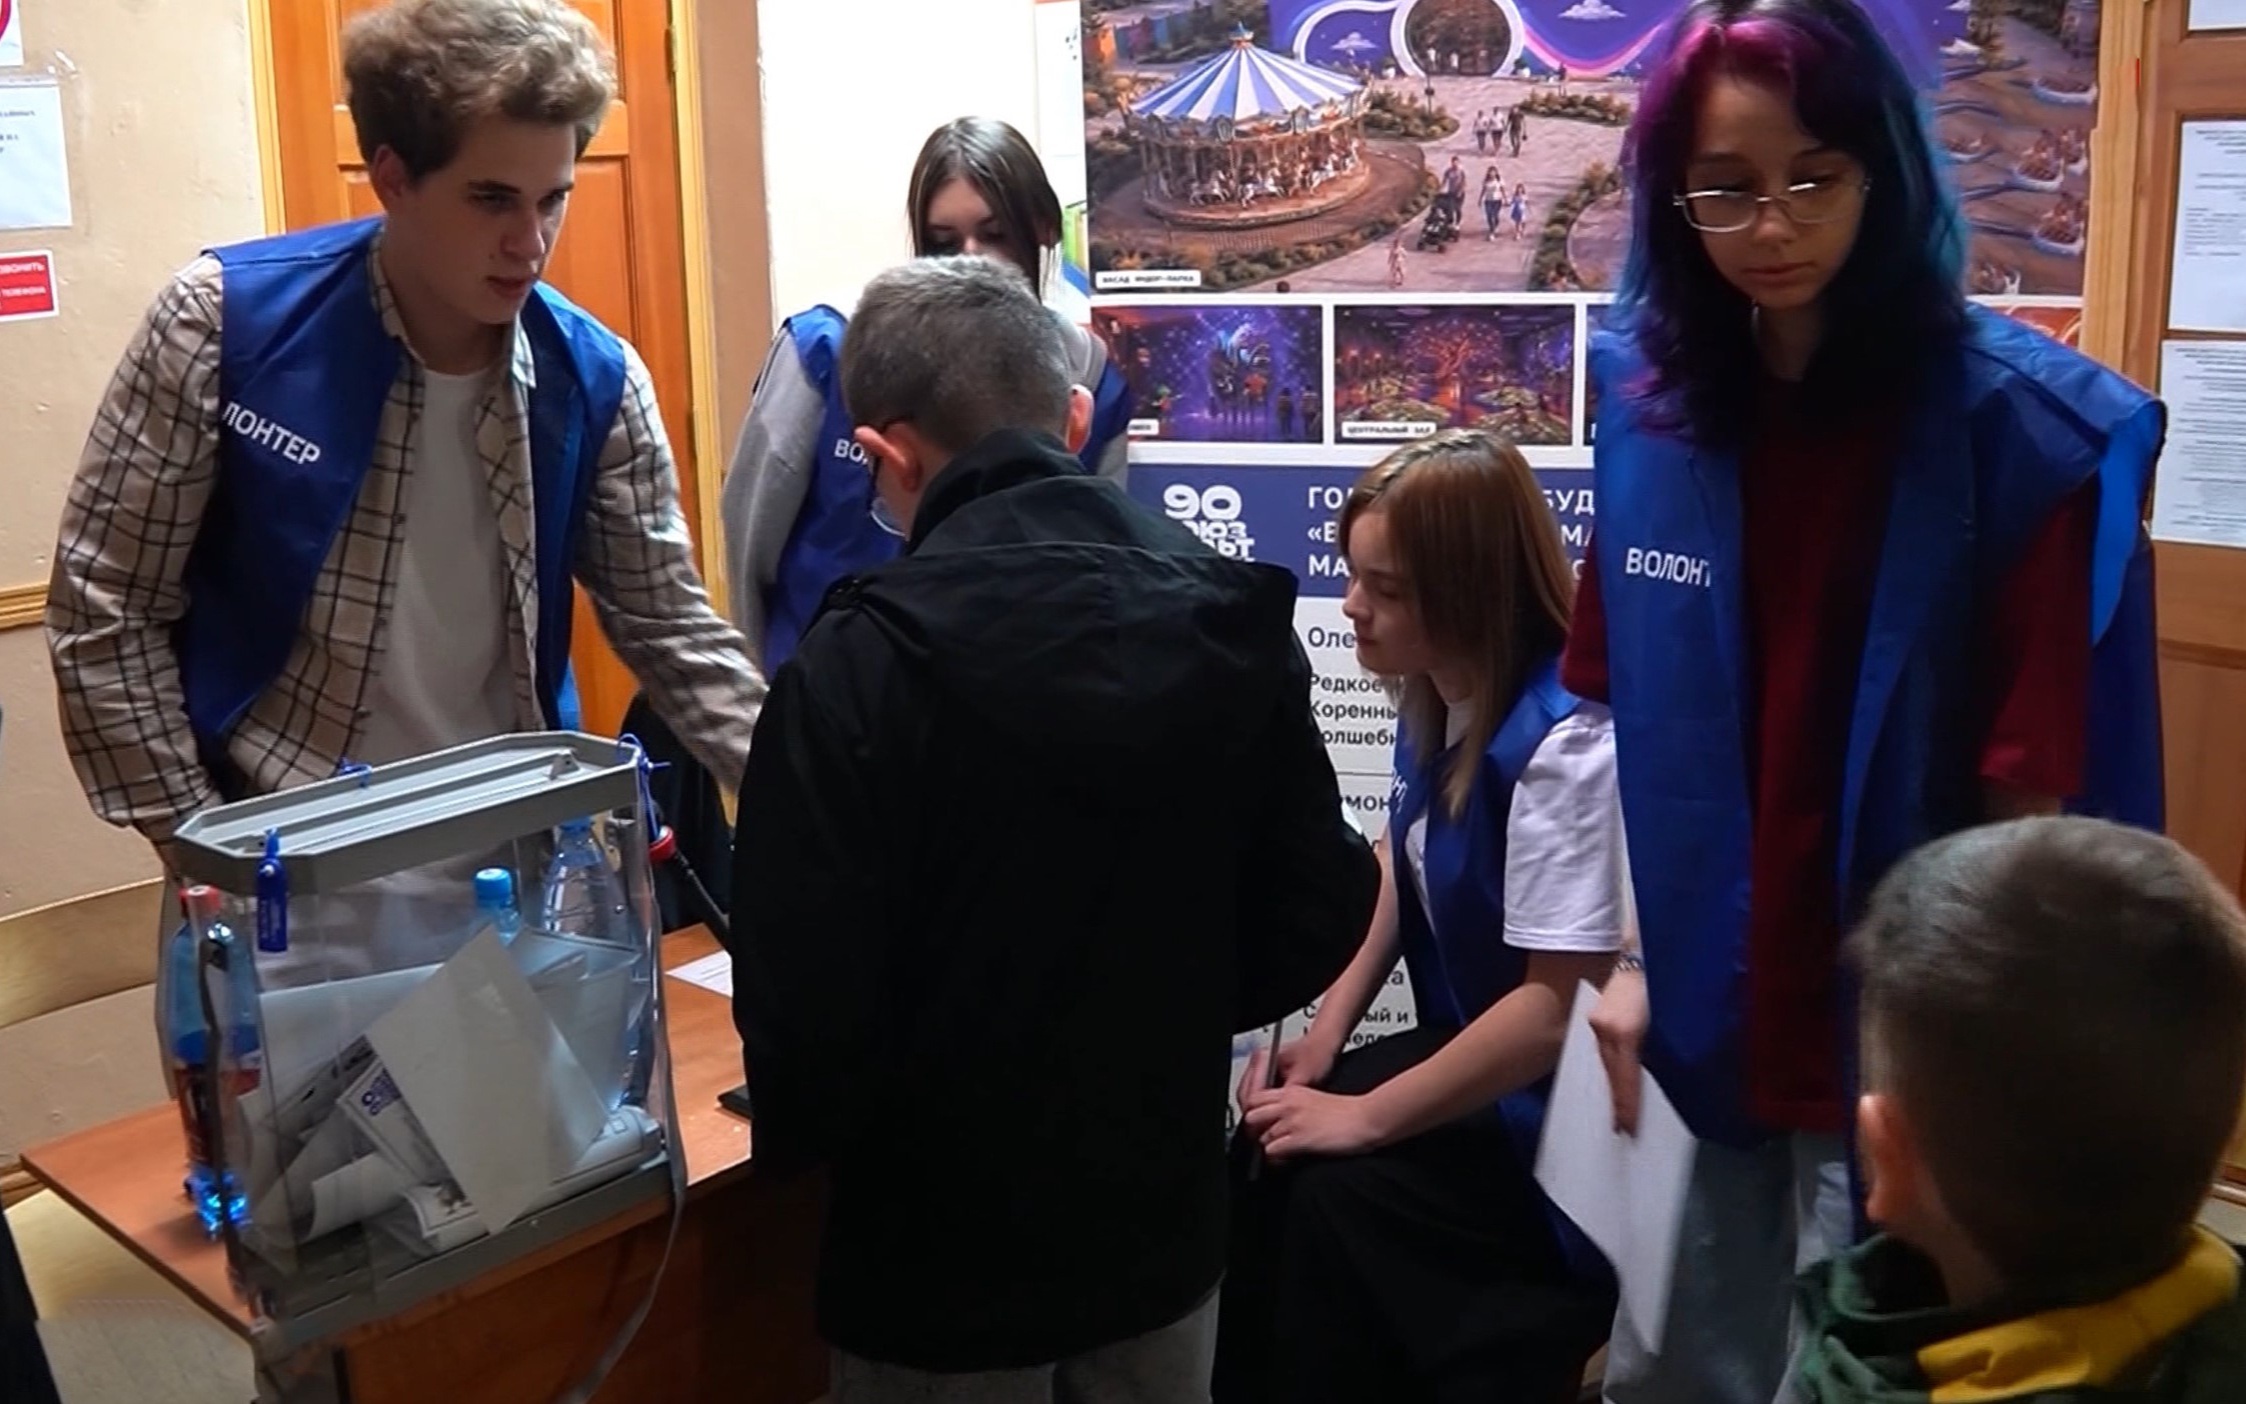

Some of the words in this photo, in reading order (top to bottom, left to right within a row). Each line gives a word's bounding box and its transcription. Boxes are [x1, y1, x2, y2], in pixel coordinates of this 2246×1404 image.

[834, 438, 868, 465] ВО
[1163, 484, 1242, 520] 90
[1308, 486, 1354, 510] ГО
[1308, 553, 1351, 577] МА
